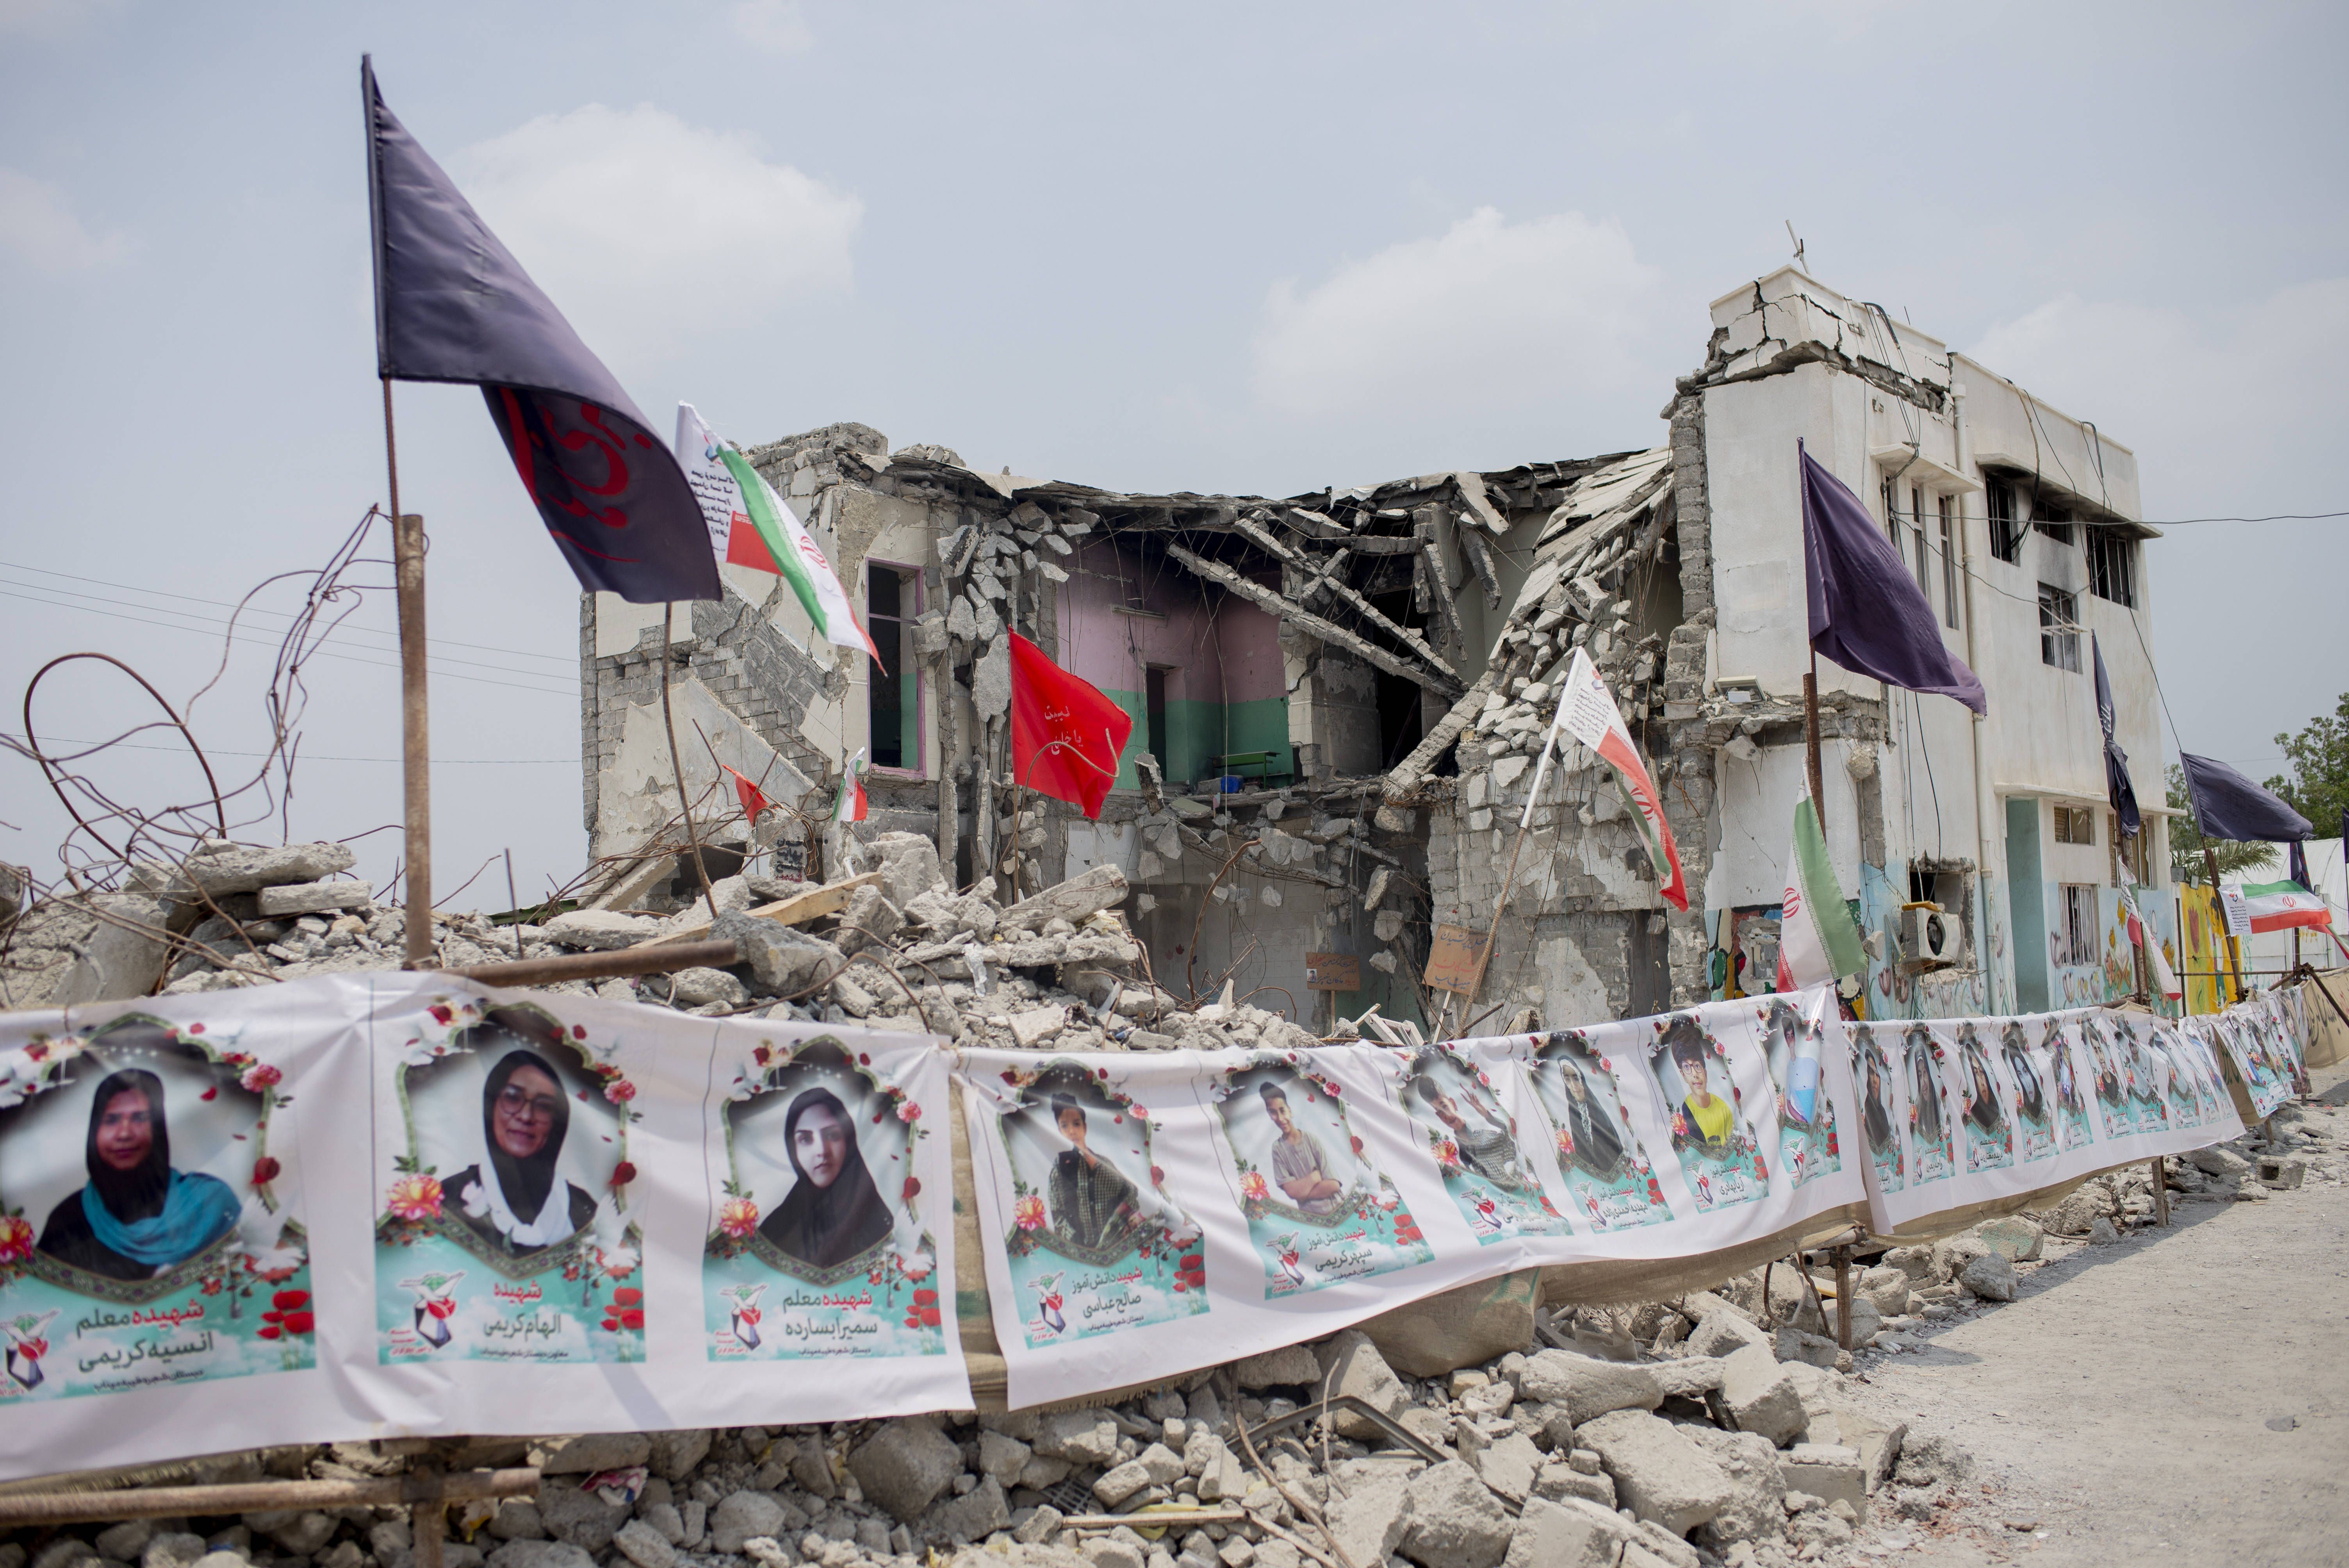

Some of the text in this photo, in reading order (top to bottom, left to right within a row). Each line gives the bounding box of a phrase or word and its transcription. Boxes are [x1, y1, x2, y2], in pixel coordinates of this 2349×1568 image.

[1710, 1165, 1718, 1178] آموز
[1719, 1164, 1730, 1176] دانش
[1597, 1187, 1608, 1201] آموز
[1608, 1187, 1620, 1199] دانش
[1308, 1226, 1366, 1251] شهید دانش آموز
[1315, 1249, 1372, 1272] سپهر کریمی
[1357, 1267, 1375, 1276] دبستان
[494, 1279, 542, 1304] شهیده
[1072, 1266, 1142, 1294] شهید دانش آموز
[783, 1288, 872, 1315] شهیده معلم
[1083, 1292, 1141, 1319] صالح عباسی
[77, 1299, 204, 1339] شهیده معلم
[483, 1313, 561, 1342] الهام کریمی
[786, 1316, 877, 1340] سمیرا بسارده
[78, 1330, 214, 1373] انسیه کریمی
